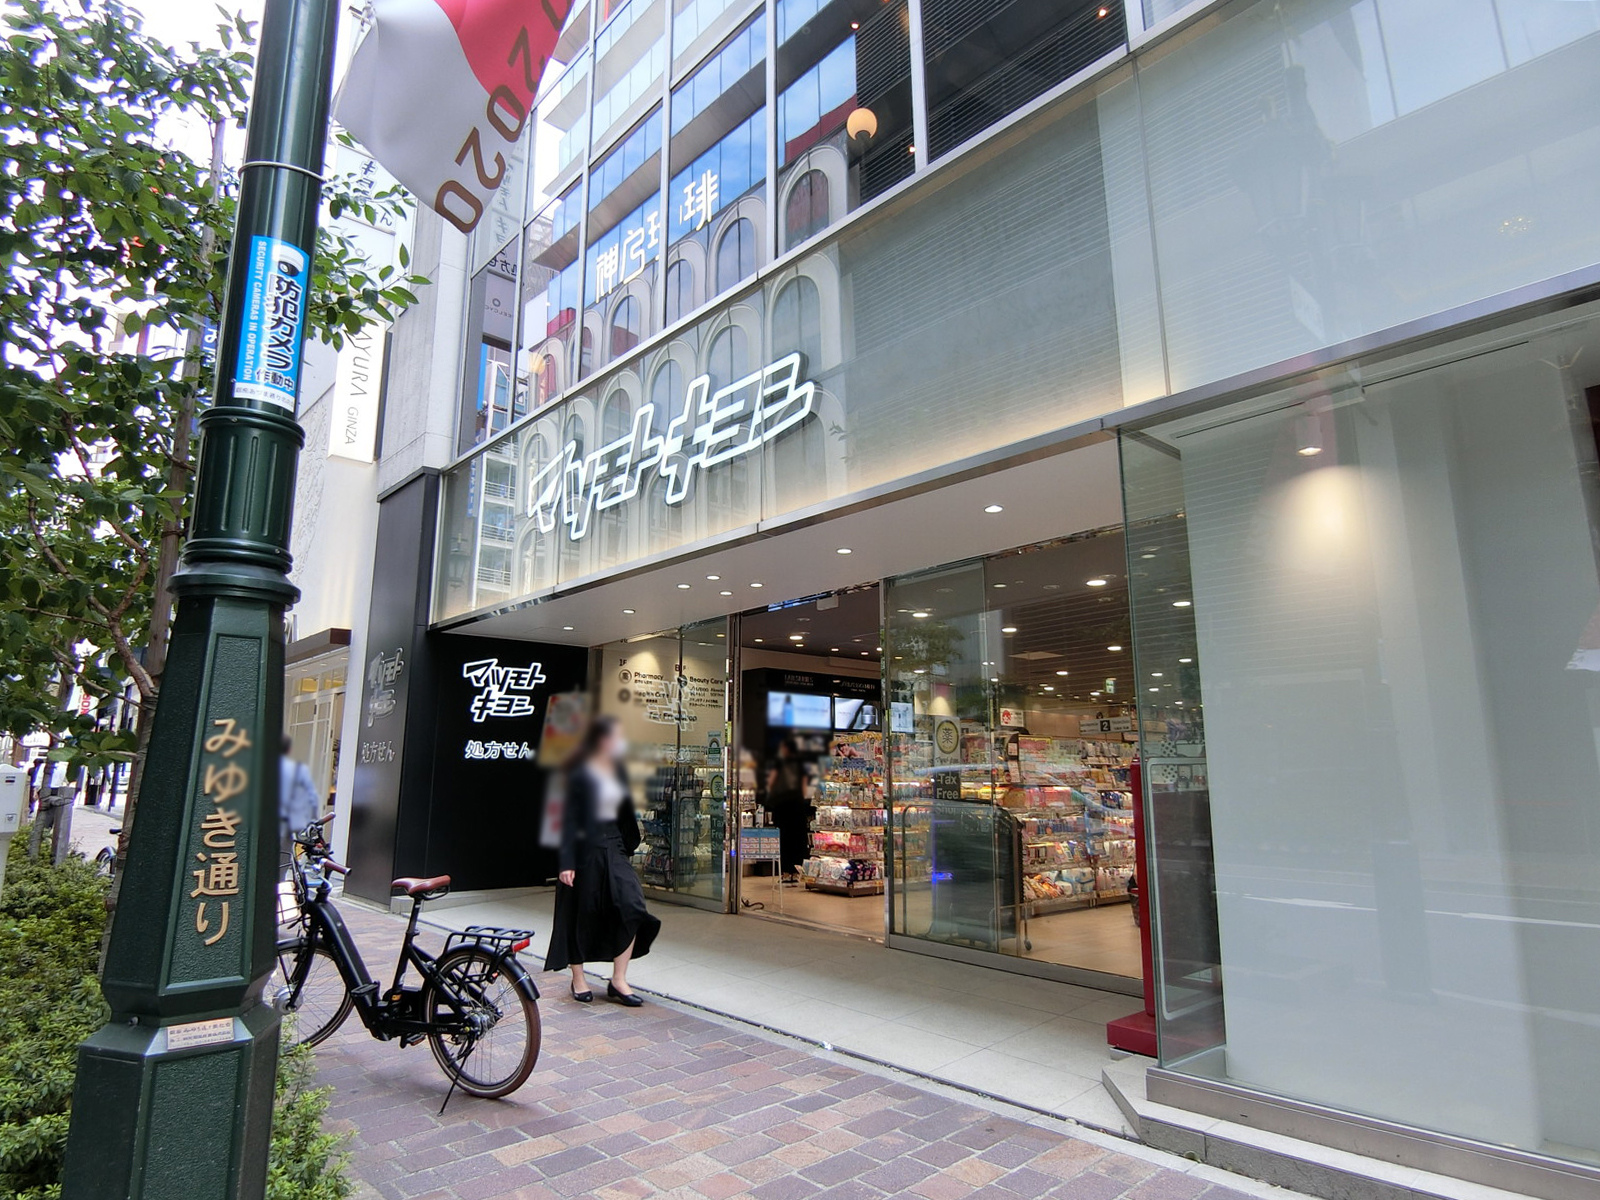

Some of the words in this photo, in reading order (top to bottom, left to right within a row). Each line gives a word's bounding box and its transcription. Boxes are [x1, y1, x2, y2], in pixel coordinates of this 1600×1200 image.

[253, 241, 267, 280] SECURITY
[250, 282, 262, 320] CAMERAS
[249, 322, 258, 331] IN
[263, 274, 302, 369] 防犯カメラ
[243, 334, 256, 380] OPERATION
[350, 330, 373, 396] AYURA
[256, 369, 294, 390] 作動中
[345, 406, 359, 445] GINZA
[526, 351, 815, 541] マツモトキヨシ
[462, 658, 547, 694] マツモト
[634, 671, 664, 681] Pharmacy
[689, 676, 709, 685] Beauty
[470, 687, 536, 723] キヨシ
[360, 741, 396, 763] 処方せん
[464, 740, 536, 760] 処方せん
[936, 787, 959, 800] Free
[938, 773, 957, 785] Tax
[190, 718, 252, 946] みゆき通り
[712, 830, 724, 839] Fre
